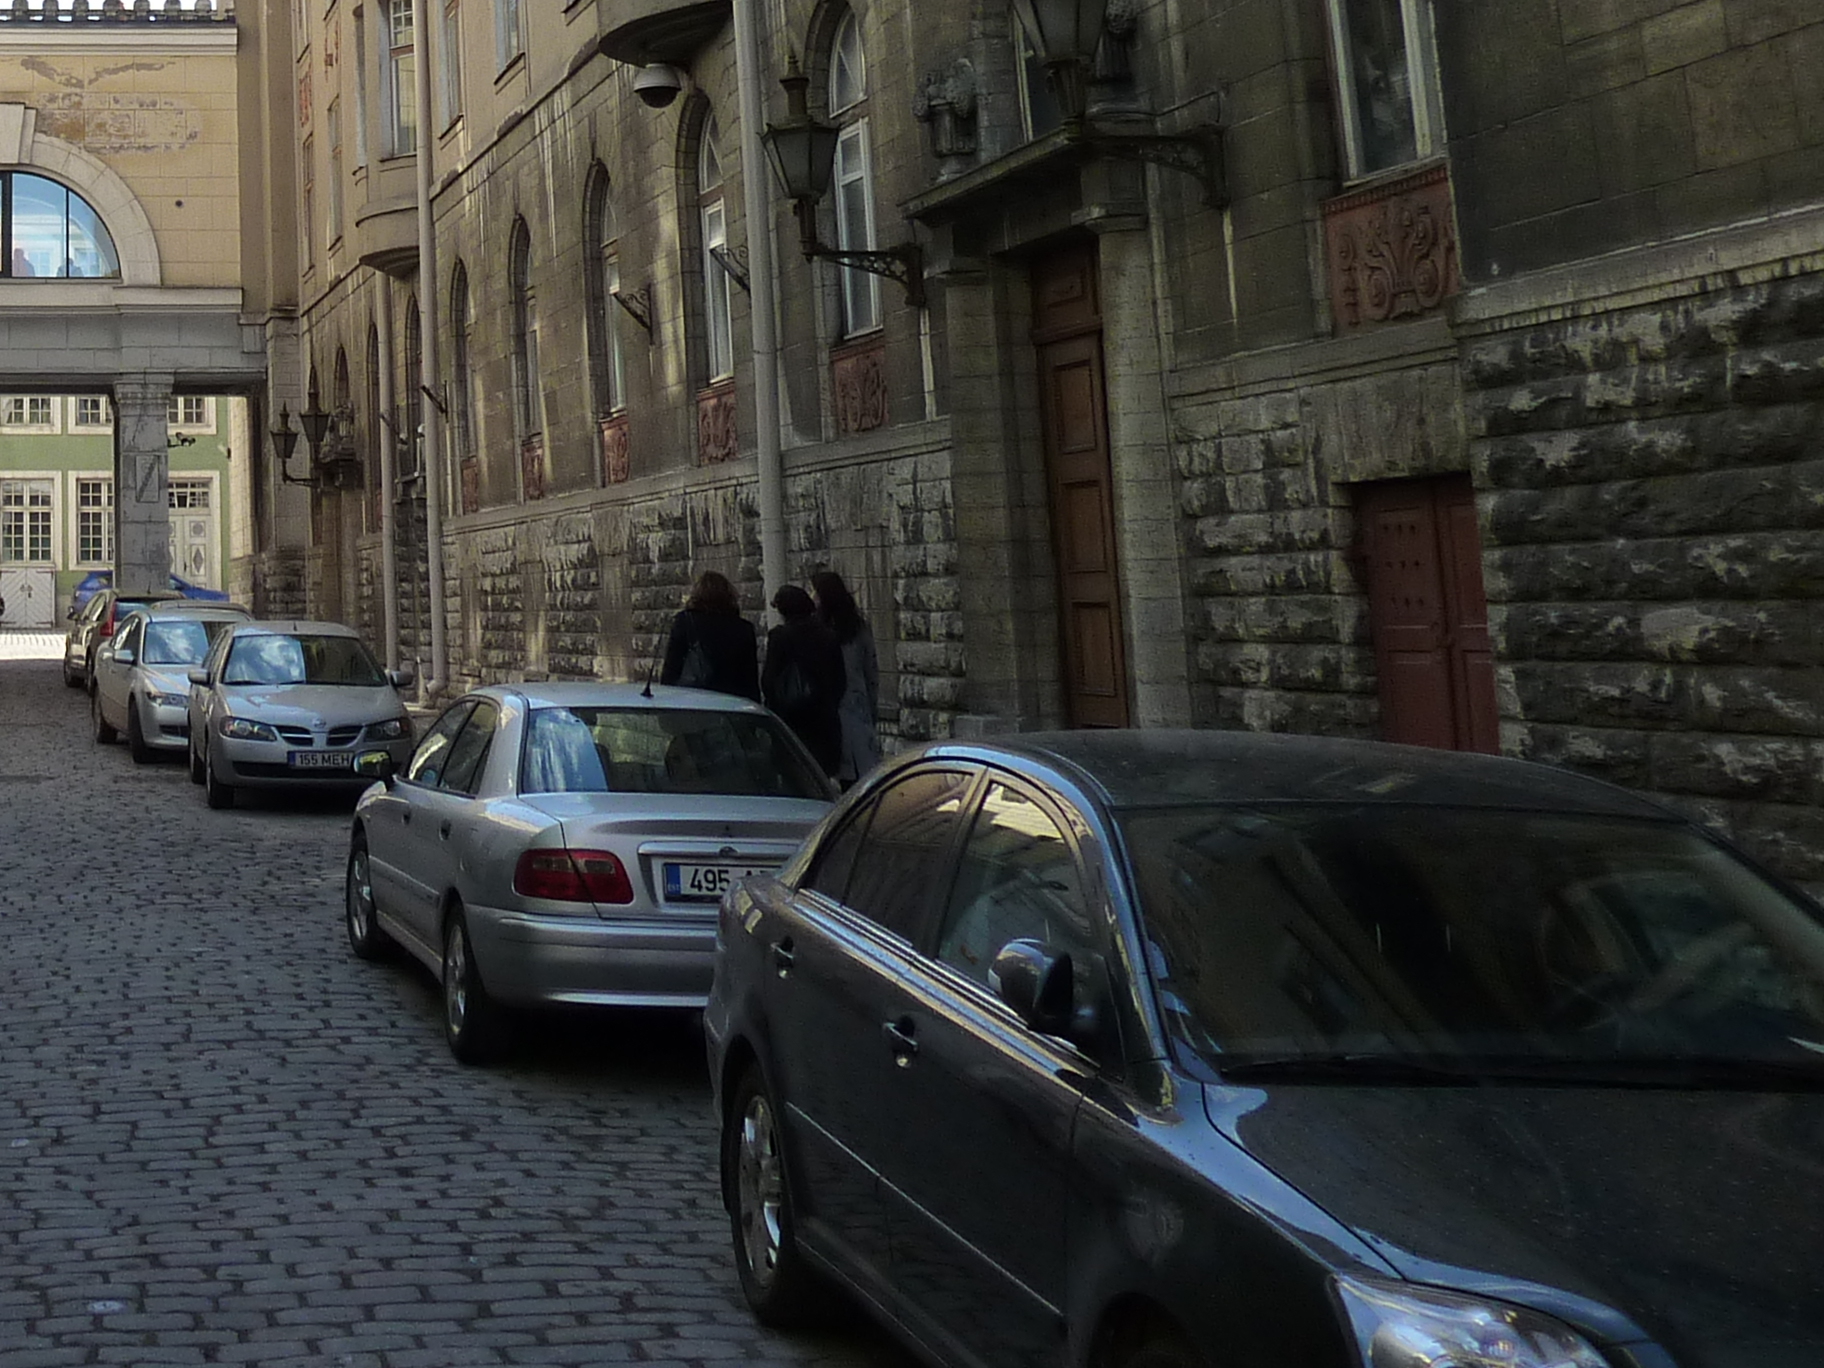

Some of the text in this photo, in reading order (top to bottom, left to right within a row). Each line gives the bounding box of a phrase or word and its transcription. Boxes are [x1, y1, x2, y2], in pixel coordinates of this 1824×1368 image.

[299, 754, 350, 766] 155 MEH
[689, 868, 731, 892] 495
